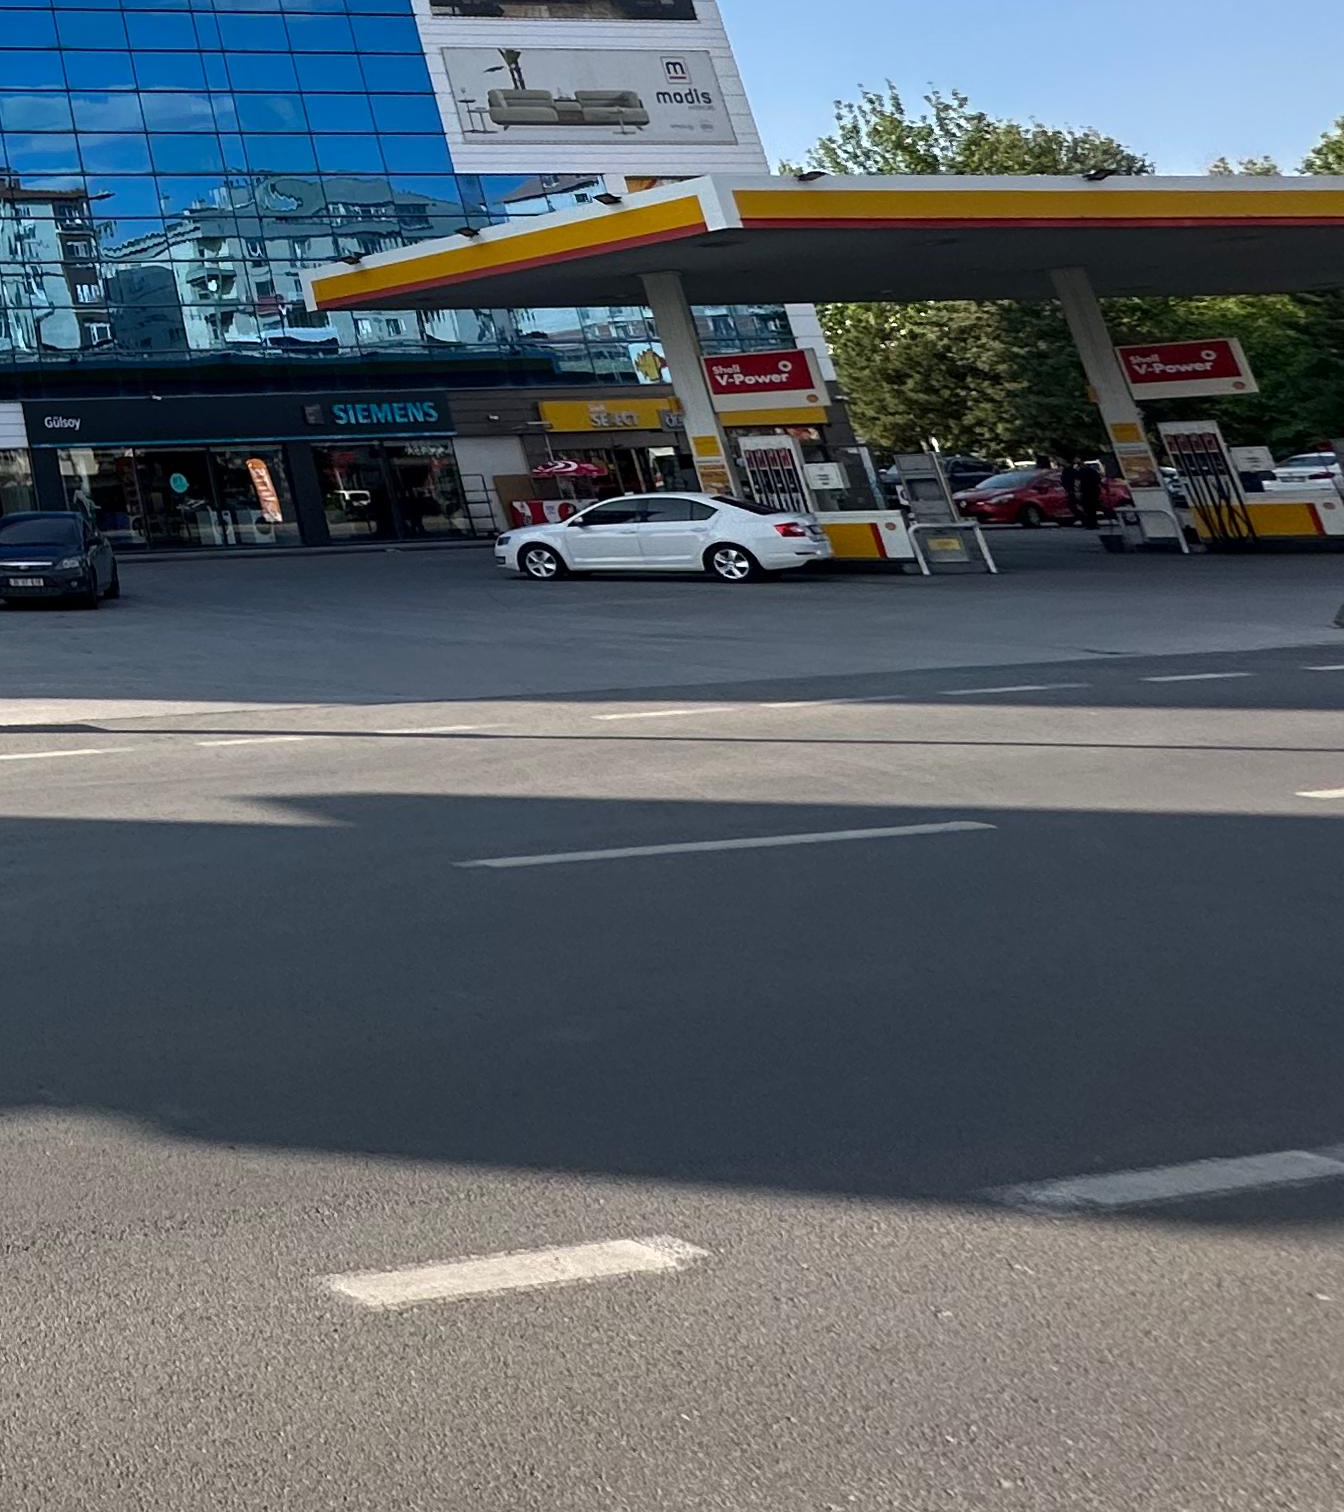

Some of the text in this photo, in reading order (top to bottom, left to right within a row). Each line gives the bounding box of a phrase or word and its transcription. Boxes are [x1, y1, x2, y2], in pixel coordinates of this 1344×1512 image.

[656, 88, 712, 104] modis
[712, 364, 741, 375] Shell
[1133, 362, 1213, 375] V-Power
[714, 372, 790, 386] V-Power
[331, 401, 439, 425] SIEMENS
[44, 416, 81, 431] Gülsoy
